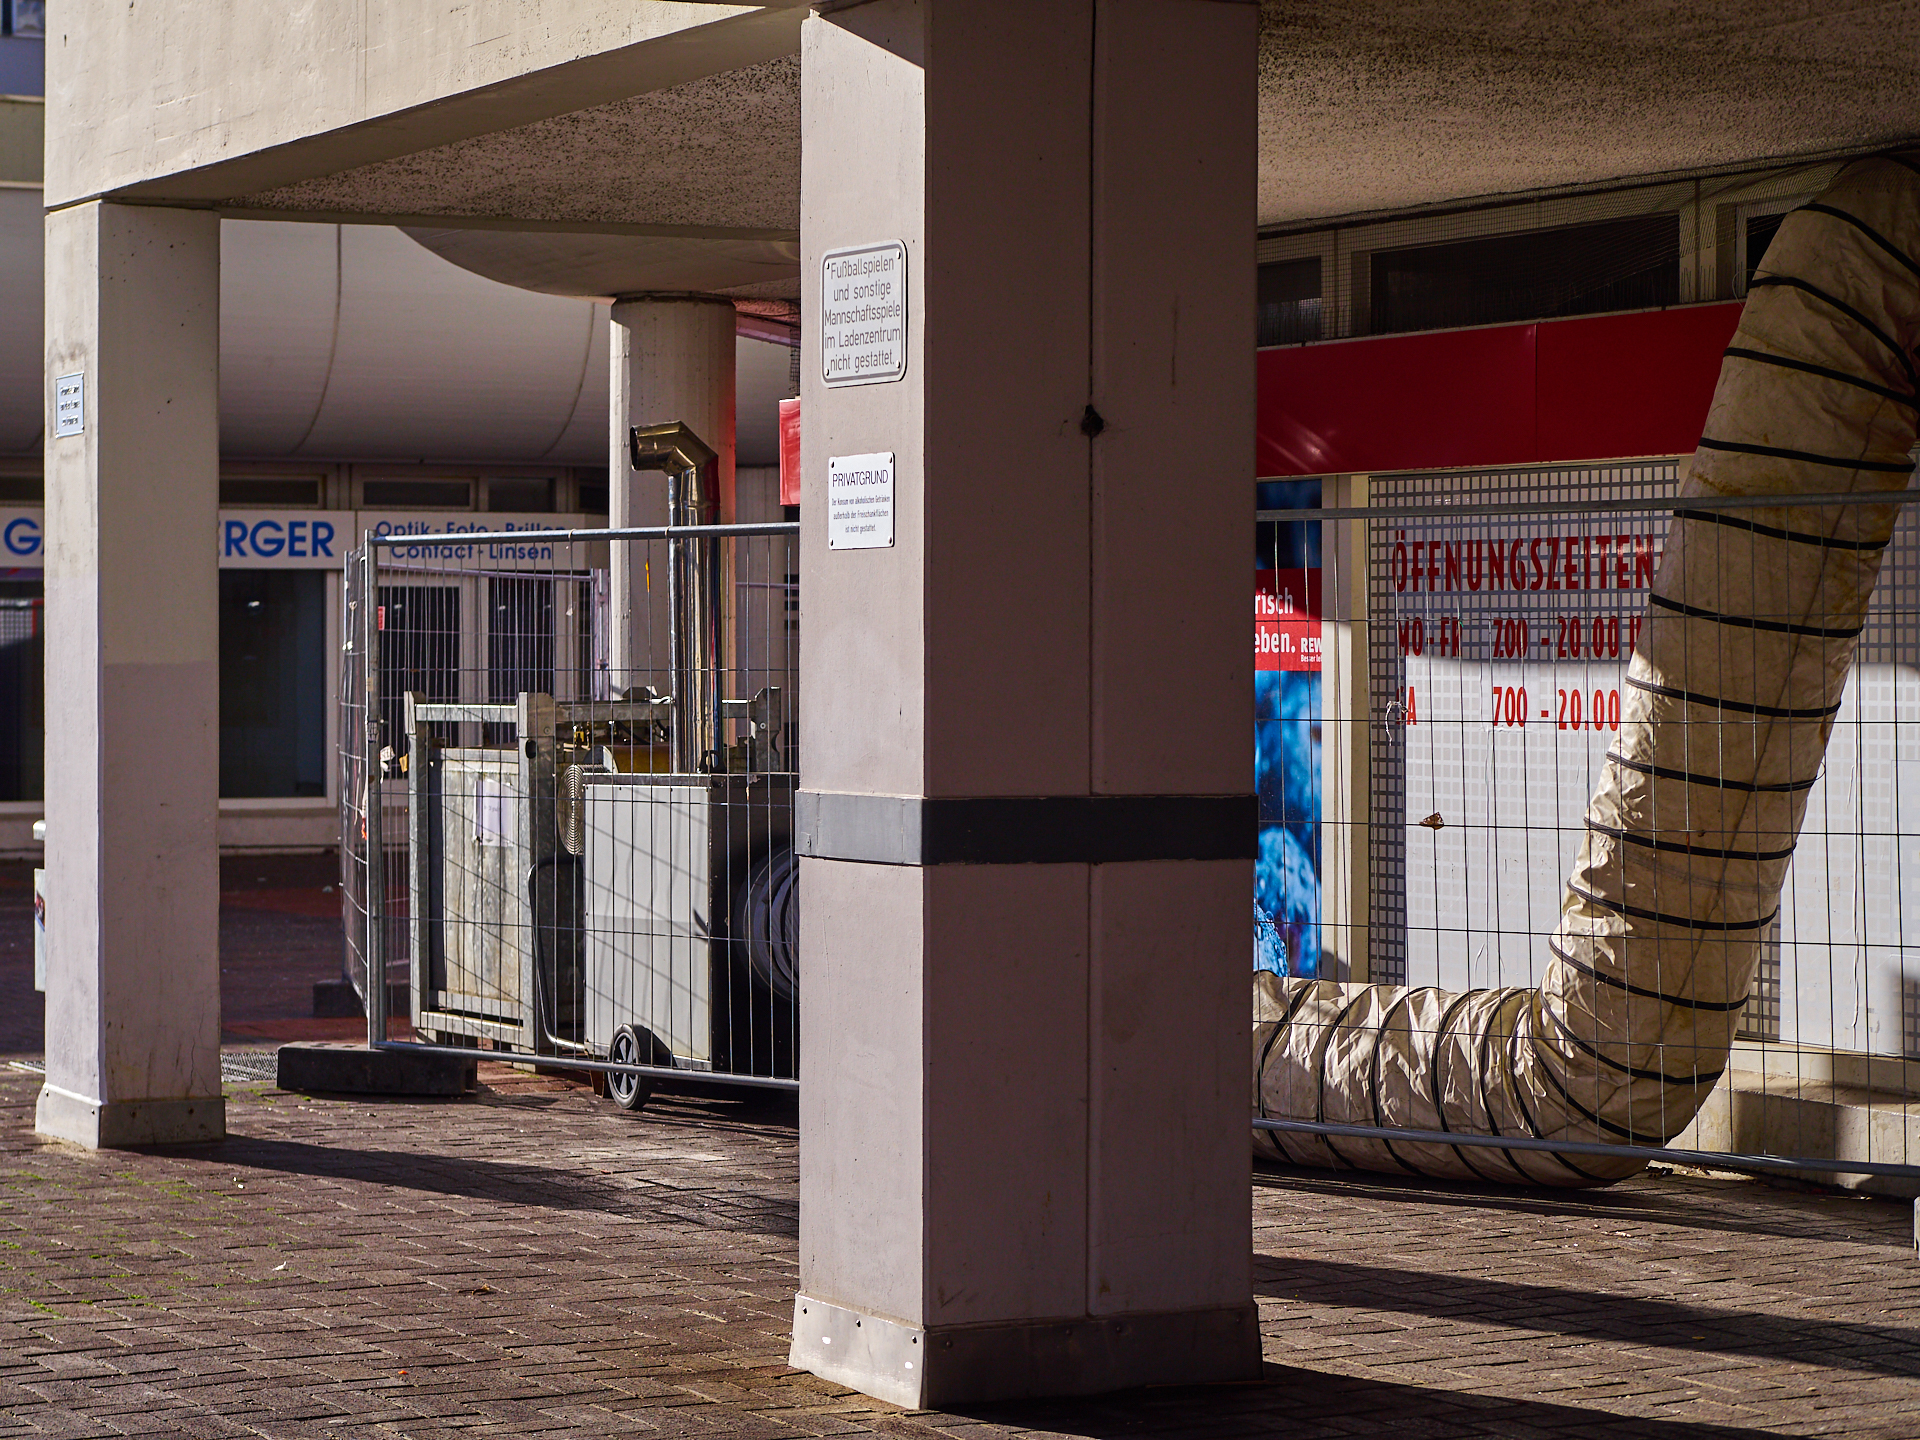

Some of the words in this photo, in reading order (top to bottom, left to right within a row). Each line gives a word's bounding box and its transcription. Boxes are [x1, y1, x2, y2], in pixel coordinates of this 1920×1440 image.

[830, 255, 894, 280] Fußballspielen
[833, 284, 849, 302] und
[853, 279, 891, 300] sonstige
[824, 300, 901, 326] Mannschaftsspiele
[824, 332, 836, 349] im
[838, 327, 901, 348] Ladenzentrum
[830, 353, 851, 372] nicht
[854, 348, 895, 374] gestattet.
[832, 469, 889, 488] PRIVATGRUND
[4, 517, 44, 556] G
[219, 519, 335, 557] RGER
[376, 521, 430, 537] Optik
[391, 544, 473, 559] Contact
[489, 543, 552, 560] Linsen
[1557, 615, 1619, 658] 20.00
[1558, 688, 1620, 732] 20.00
